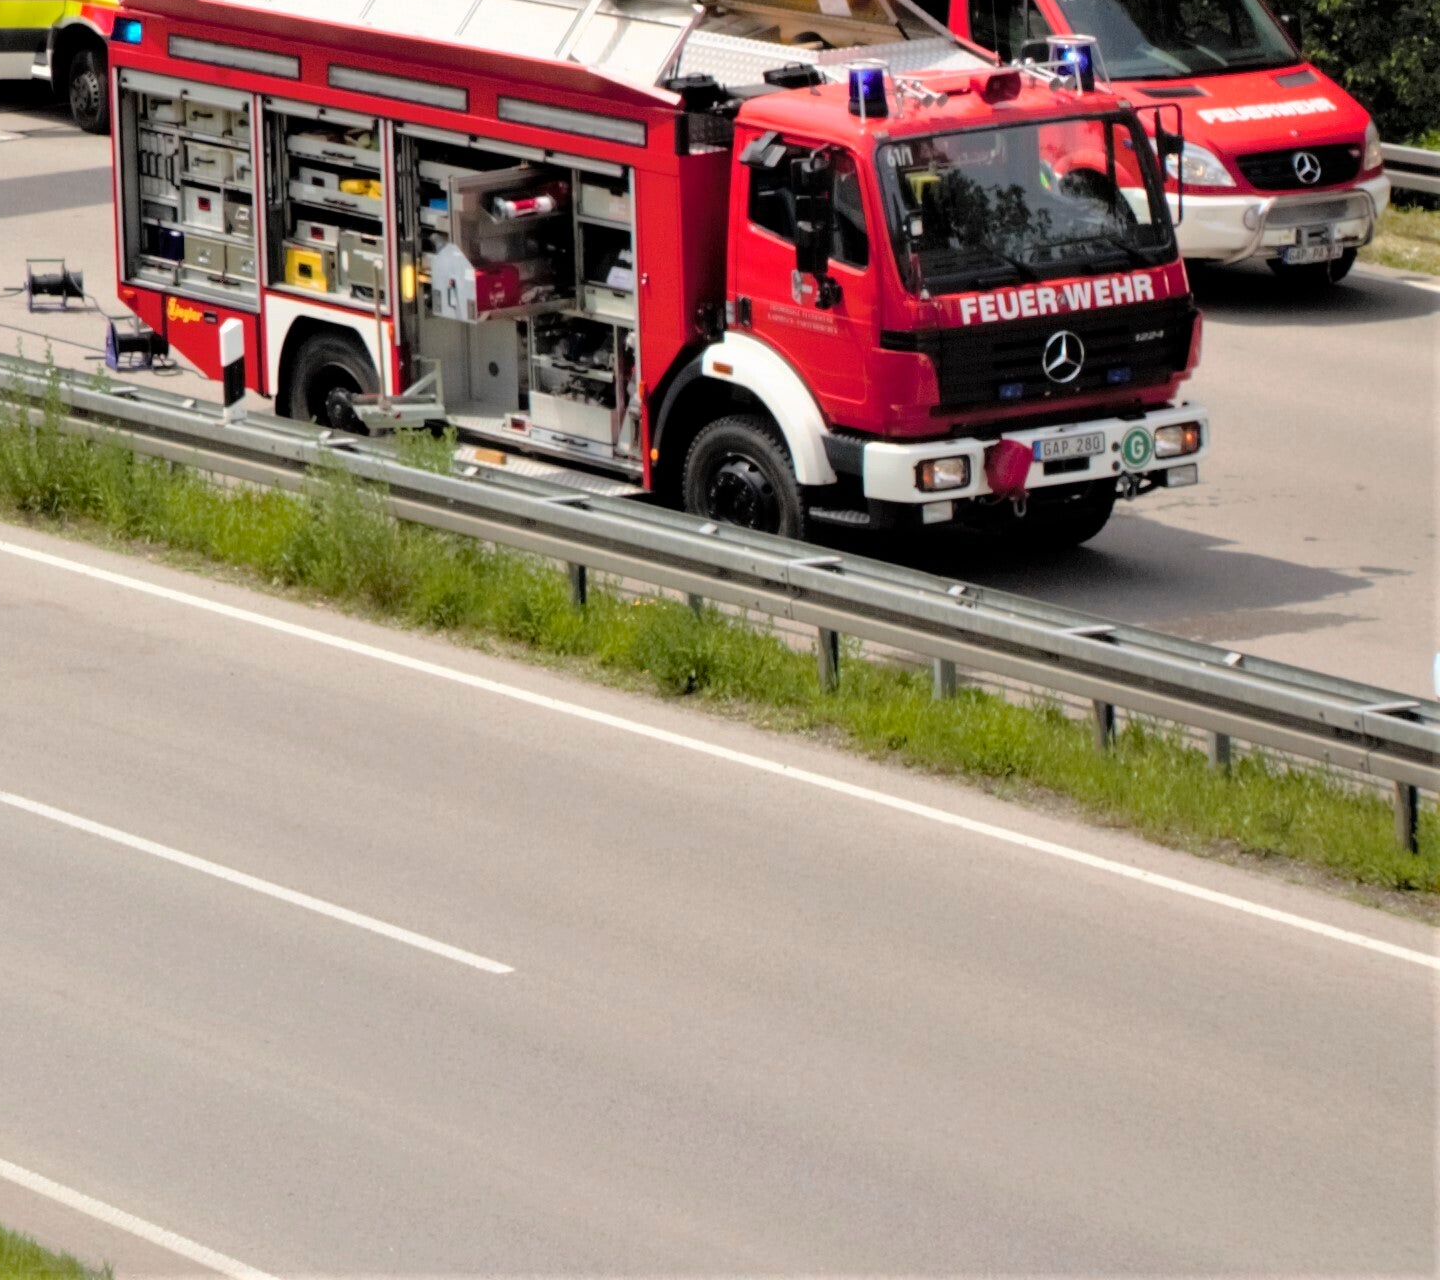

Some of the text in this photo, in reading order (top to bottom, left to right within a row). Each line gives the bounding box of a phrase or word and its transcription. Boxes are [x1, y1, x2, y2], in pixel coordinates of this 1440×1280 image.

[1196, 96, 1338, 125] FEUERWEHR
[887, 146, 914, 168] 61/1
[1134, 329, 1165, 342] 1224
[1043, 435, 1101, 458] GAP 280
[1131, 435, 1144, 459] G
